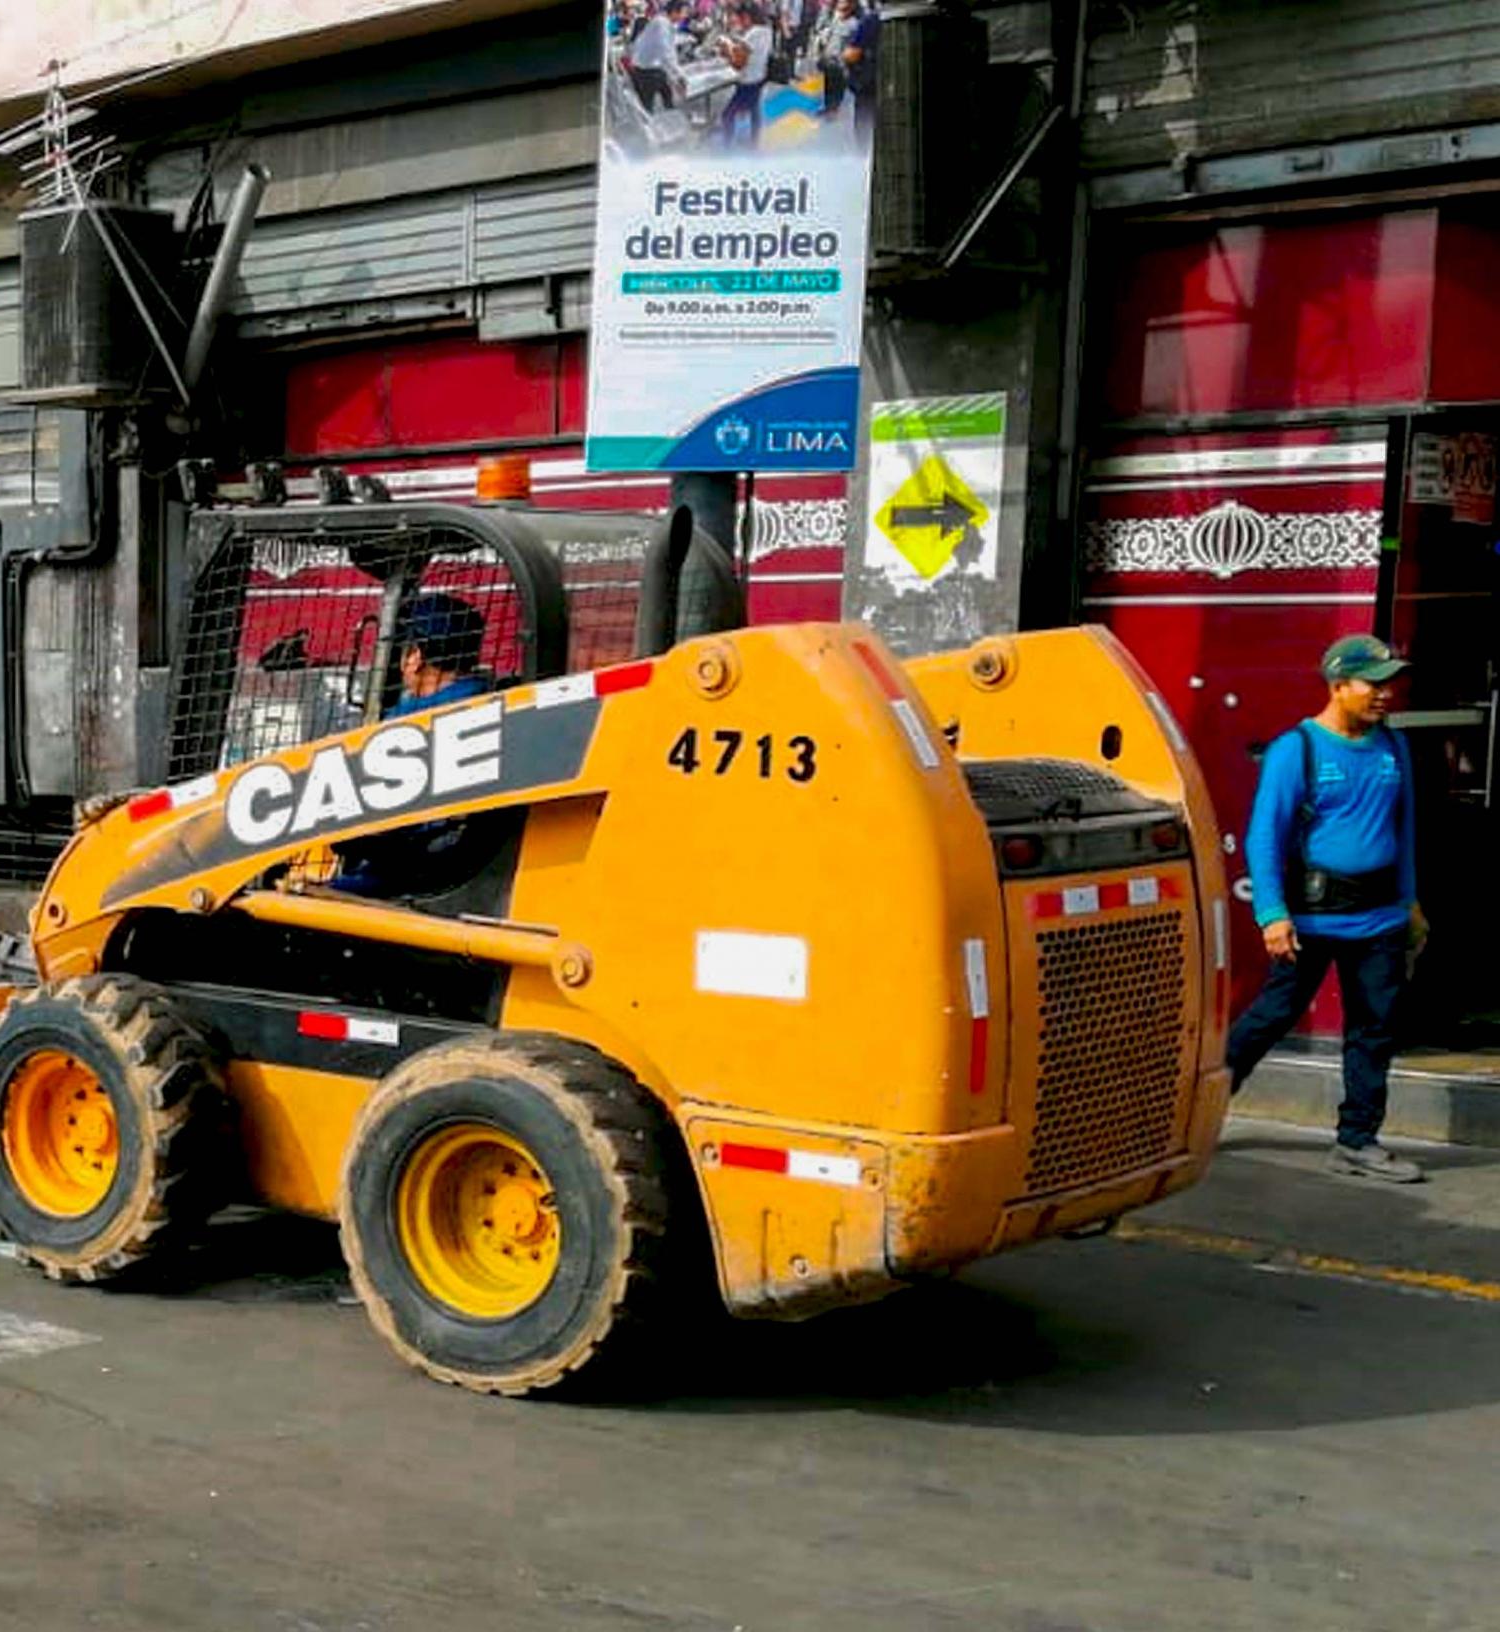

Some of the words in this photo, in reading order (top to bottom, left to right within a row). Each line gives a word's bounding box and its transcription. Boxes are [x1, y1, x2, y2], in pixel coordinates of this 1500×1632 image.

[655, 178, 808, 216] Festival
[625, 225, 682, 259] del
[692, 224, 838, 266] empleo
[756, 274, 778, 288] DE
[782, 273, 832, 288] MAYO
[767, 431, 849, 452] LIMA
[226, 700, 502, 844] CASE
[668, 727, 817, 783] 4713
